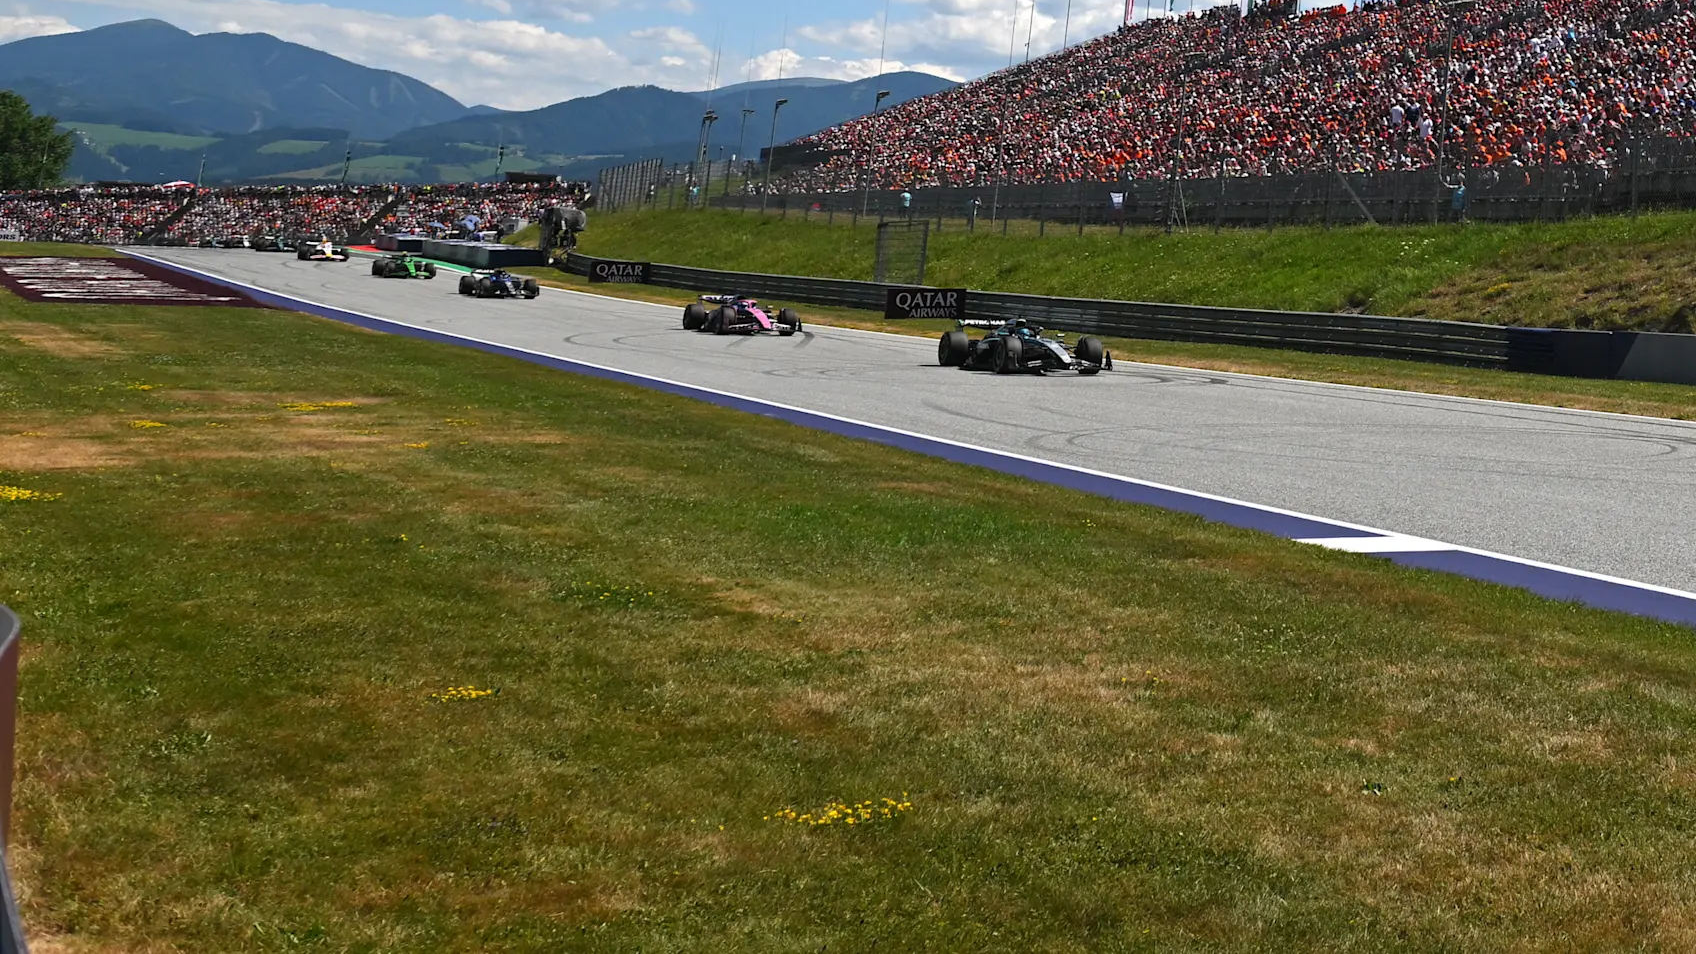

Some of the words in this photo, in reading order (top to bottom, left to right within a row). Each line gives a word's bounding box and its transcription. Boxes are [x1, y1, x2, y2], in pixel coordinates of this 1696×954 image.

[596, 264, 643, 277] QATAR
[896, 291, 958, 310] QATAR
[909, 307, 957, 318] AIRWAYS
